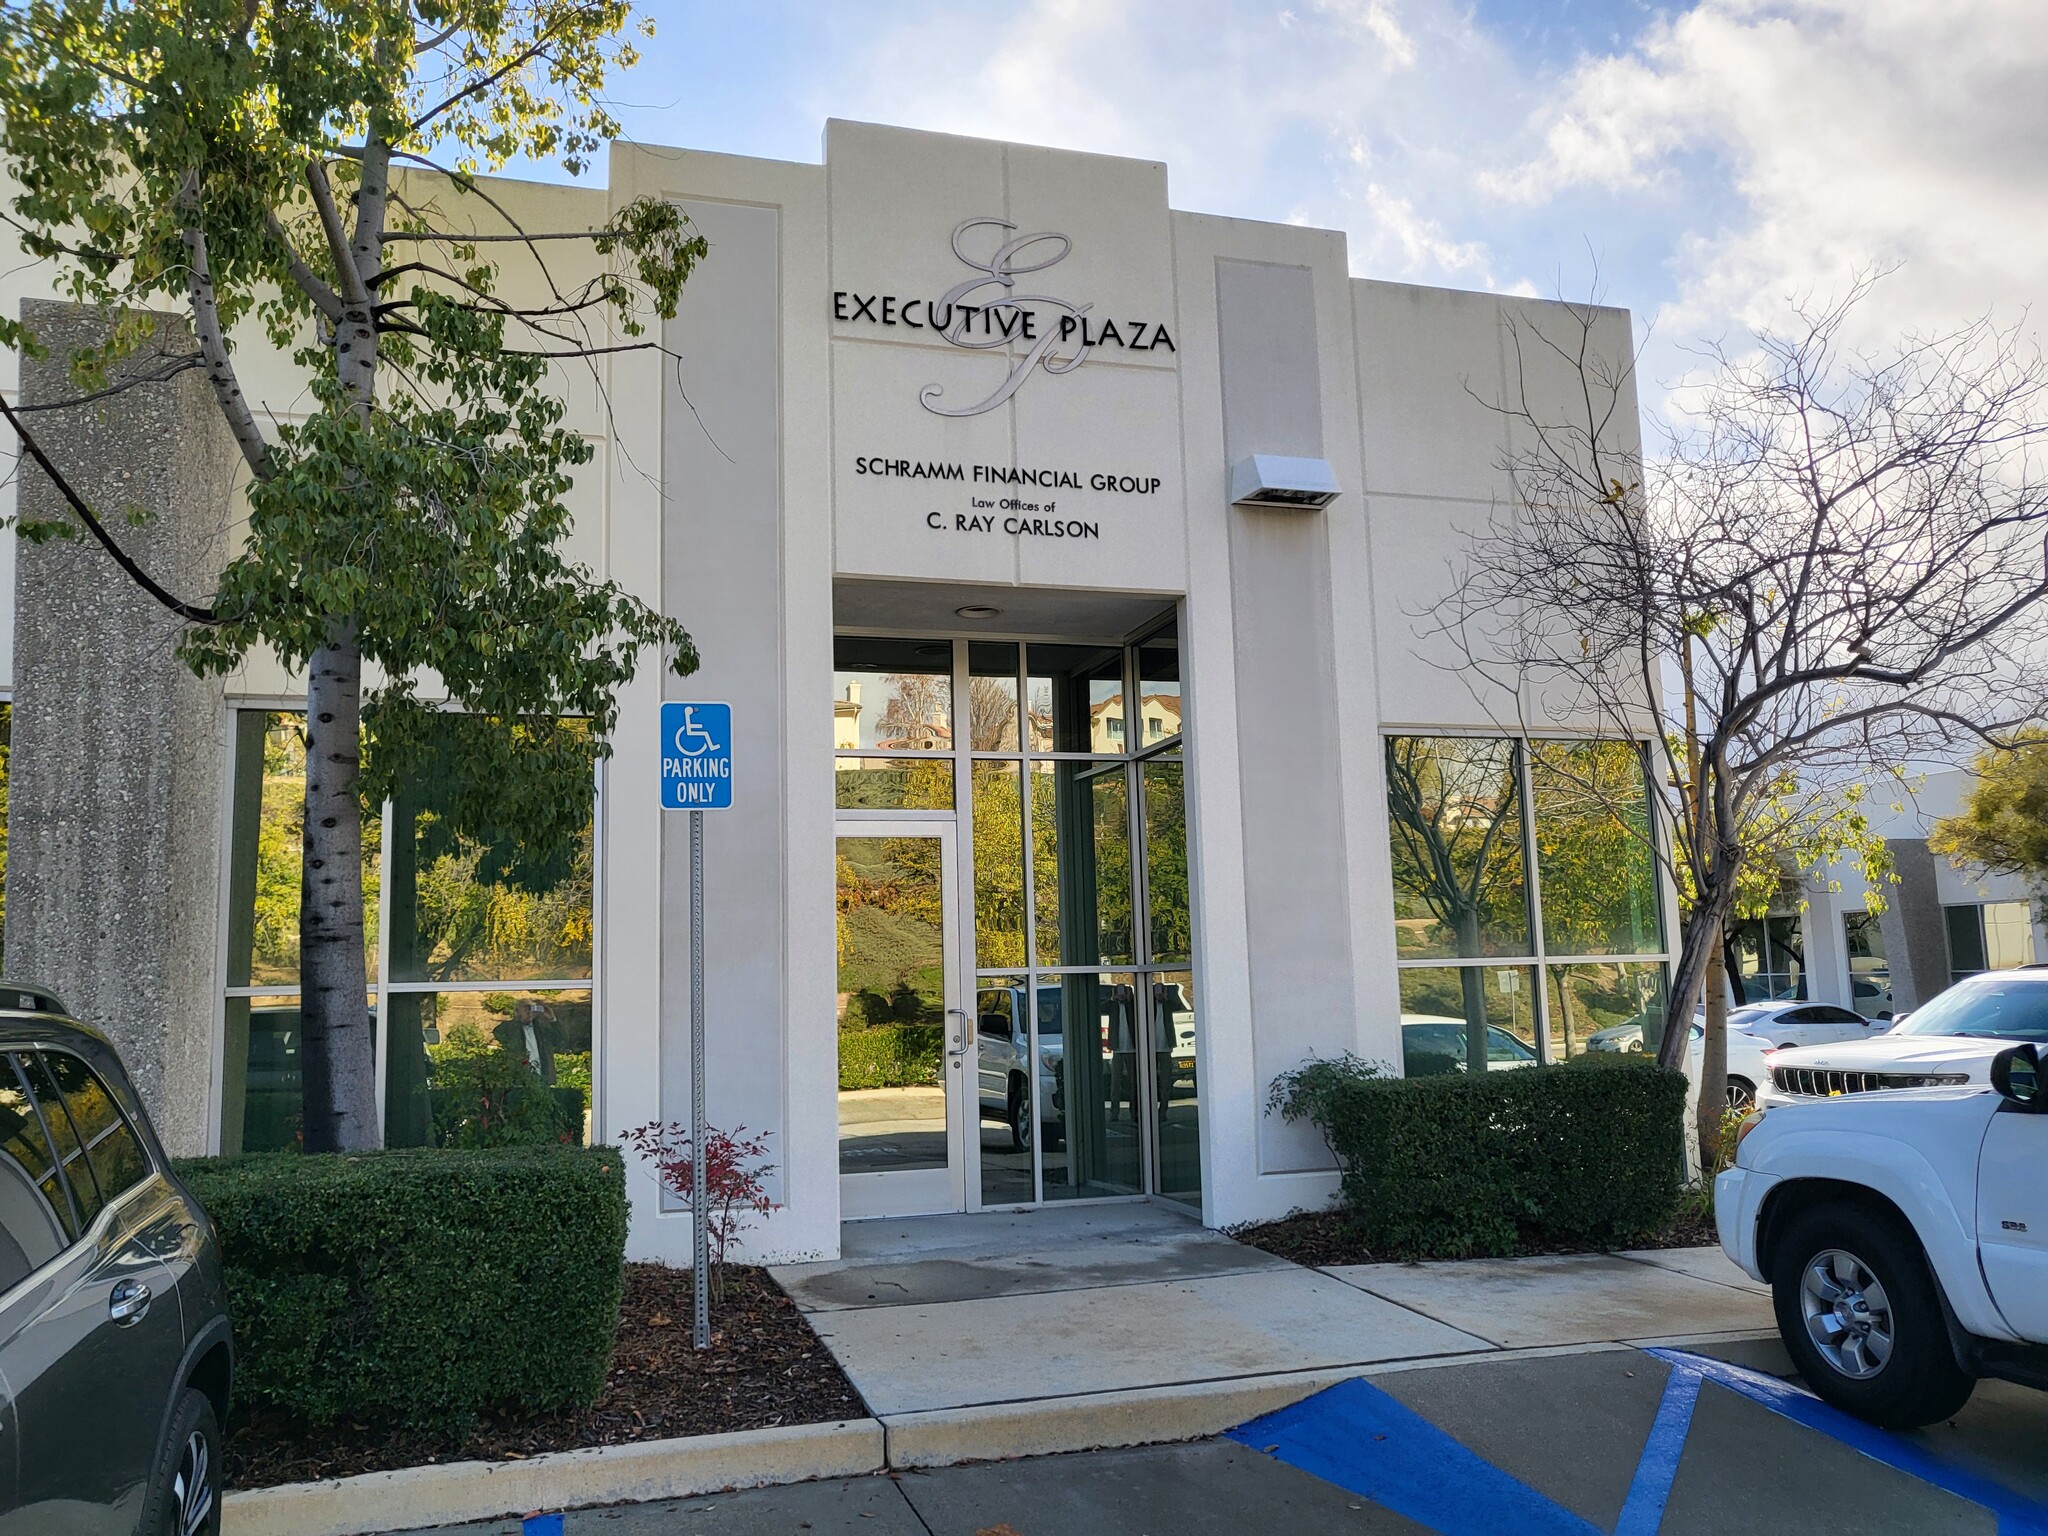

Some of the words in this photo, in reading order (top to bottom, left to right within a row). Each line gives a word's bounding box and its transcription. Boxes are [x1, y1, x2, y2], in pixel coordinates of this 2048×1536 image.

[834, 291, 1037, 339] EXECUTIVE
[1060, 315, 1176, 352] PLAZA
[855, 456, 965, 481] SCHRAMM
[972, 465, 1083, 489] FINANCIAL
[1090, 474, 1161, 494] GROUP
[971, 496, 995, 509] Law
[999, 498, 1040, 512] Offices
[1043, 501, 1056, 513] of
[926, 512, 947, 530] C.
[955, 514, 995, 533] RAY
[1003, 517, 1099, 539] CARLSON
[663, 757, 729, 778] PARKING
[677, 782, 716, 803] ONLY
